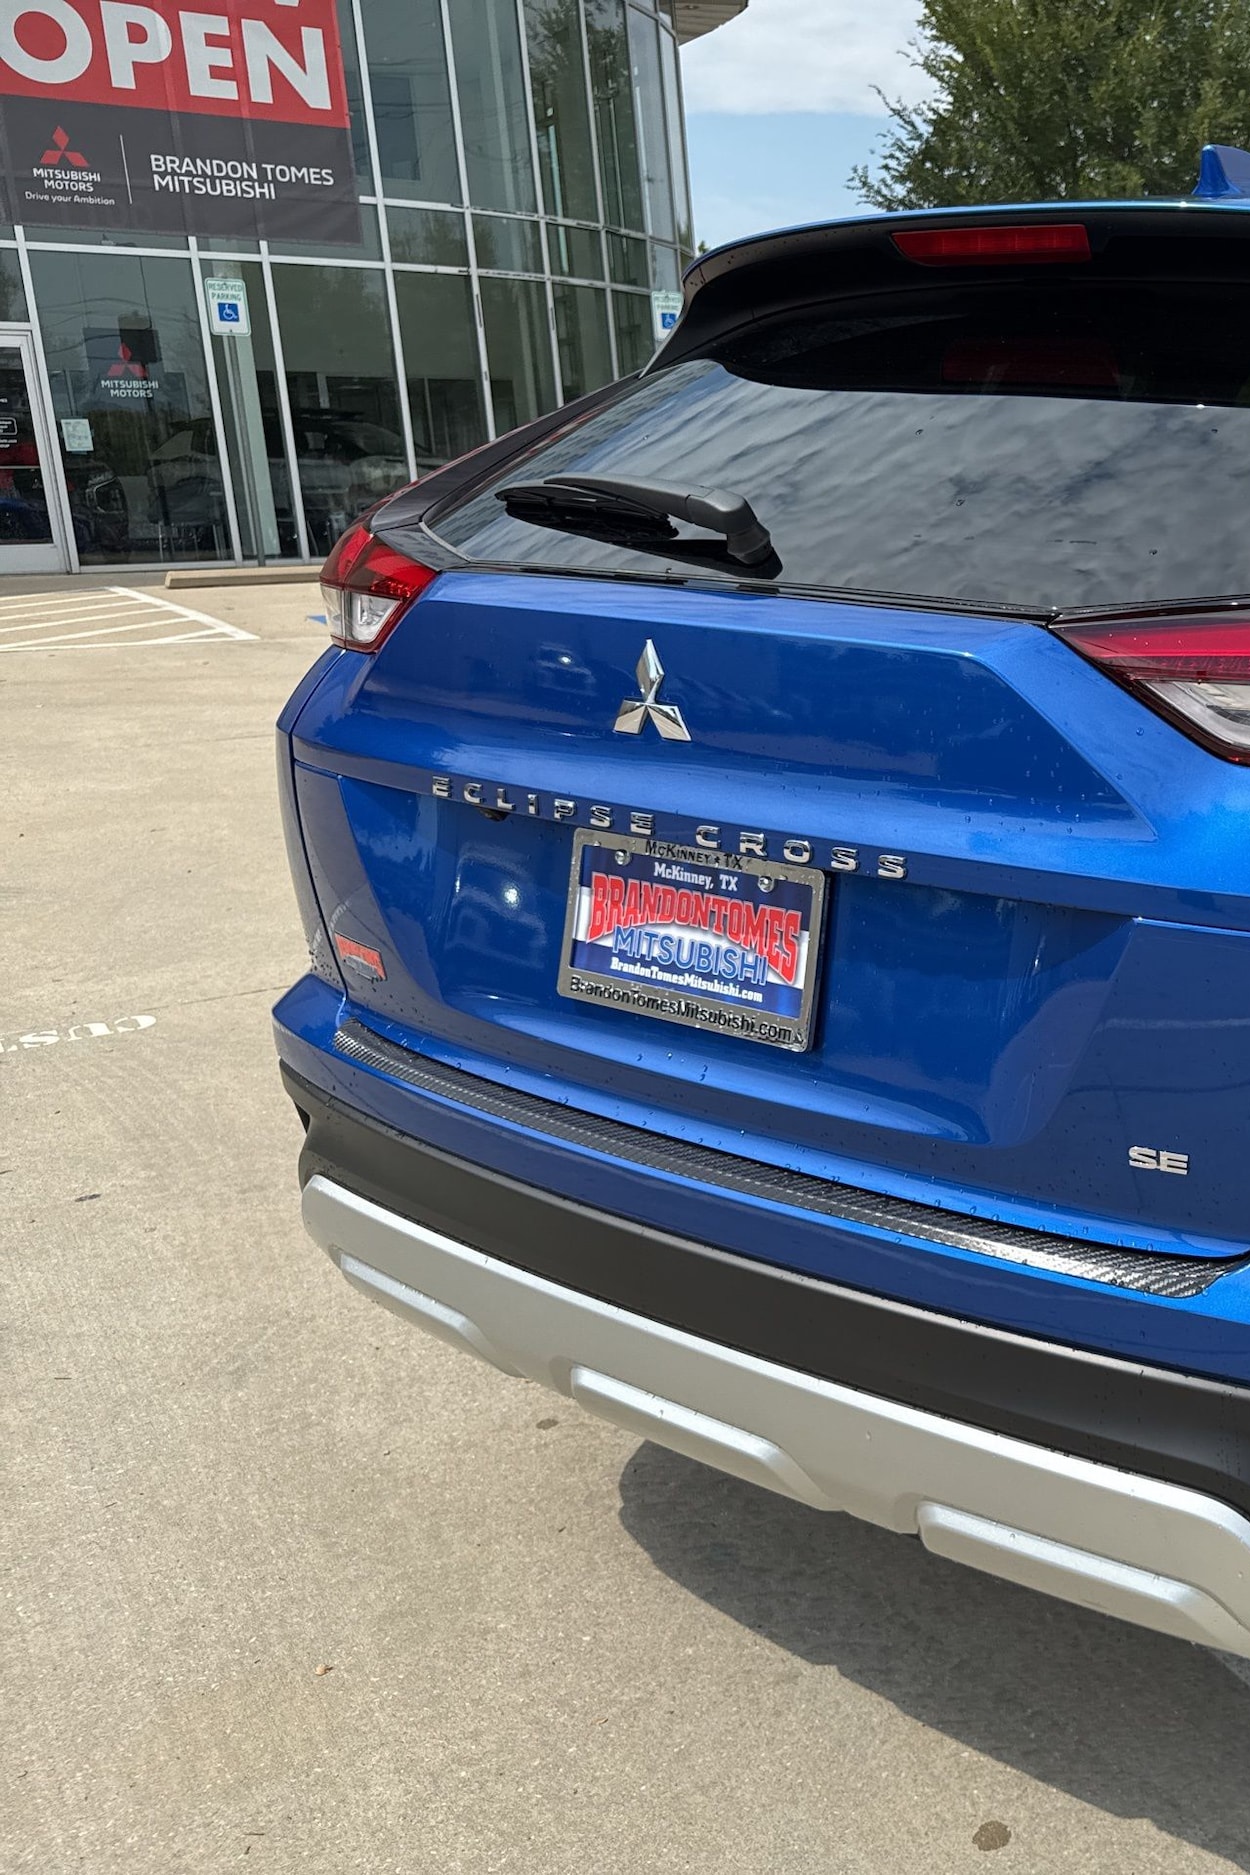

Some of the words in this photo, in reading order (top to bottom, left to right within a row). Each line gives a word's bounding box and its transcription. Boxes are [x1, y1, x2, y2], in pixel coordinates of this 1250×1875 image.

[0, 0, 332, 110] OPEN
[33, 168, 101, 183] MITSUBISHI
[150, 154, 258, 181] BRANDON
[262, 164, 334, 186] TOMES
[25, 191, 50, 202] Drive
[51, 194, 72, 204] your
[73, 195, 116, 206] Ambition
[44, 180, 94, 193] MOTORS
[153, 174, 276, 200] MITSUBISHI
[101, 380, 159, 390] MITSUBISHI
[110, 389, 153, 398] MOTORS
[432, 775, 655, 836] ECLIPSE
[696, 824, 908, 880] CROSS
[653, 861, 715, 890] McKinney,
[720, 874, 739, 892] TX
[723, 852, 743, 870] TX
[612, 925, 769, 987] MITSUBISHI
[610, 956, 764, 1003] BrandonTomesMitsubishi.com
[569, 974, 793, 1043] BrandonTomesMitsubishi.com
[1128, 1145, 1189, 1176] SE
